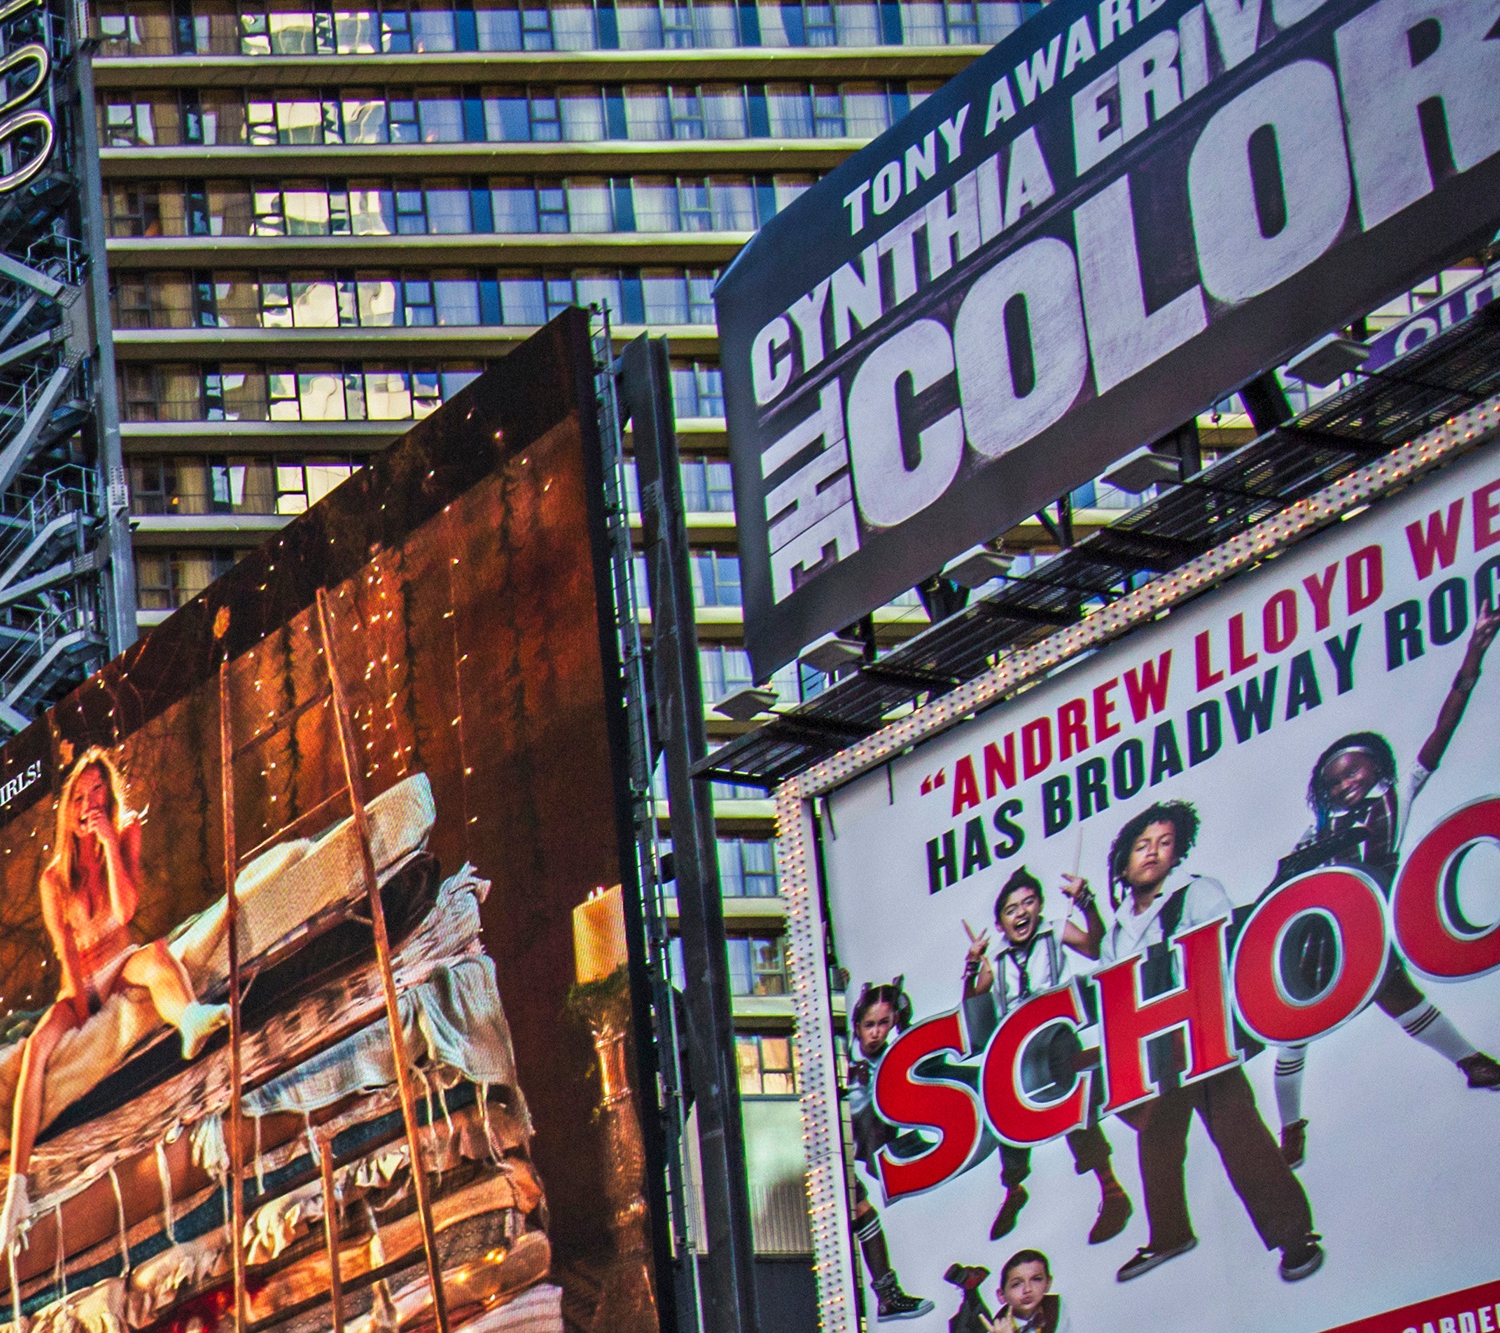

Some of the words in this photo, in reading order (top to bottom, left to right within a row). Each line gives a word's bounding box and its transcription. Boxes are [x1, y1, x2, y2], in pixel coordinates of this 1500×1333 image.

[750, 125, 1056, 407] CYNTHIA
[843, 103, 970, 237] TONY
[759, 378, 860, 605] THE
[1194, 545, 1385, 693] LLOYD
[926, 798, 1025, 895] HAS
[1041, 623, 1363, 839] BROADWAY
